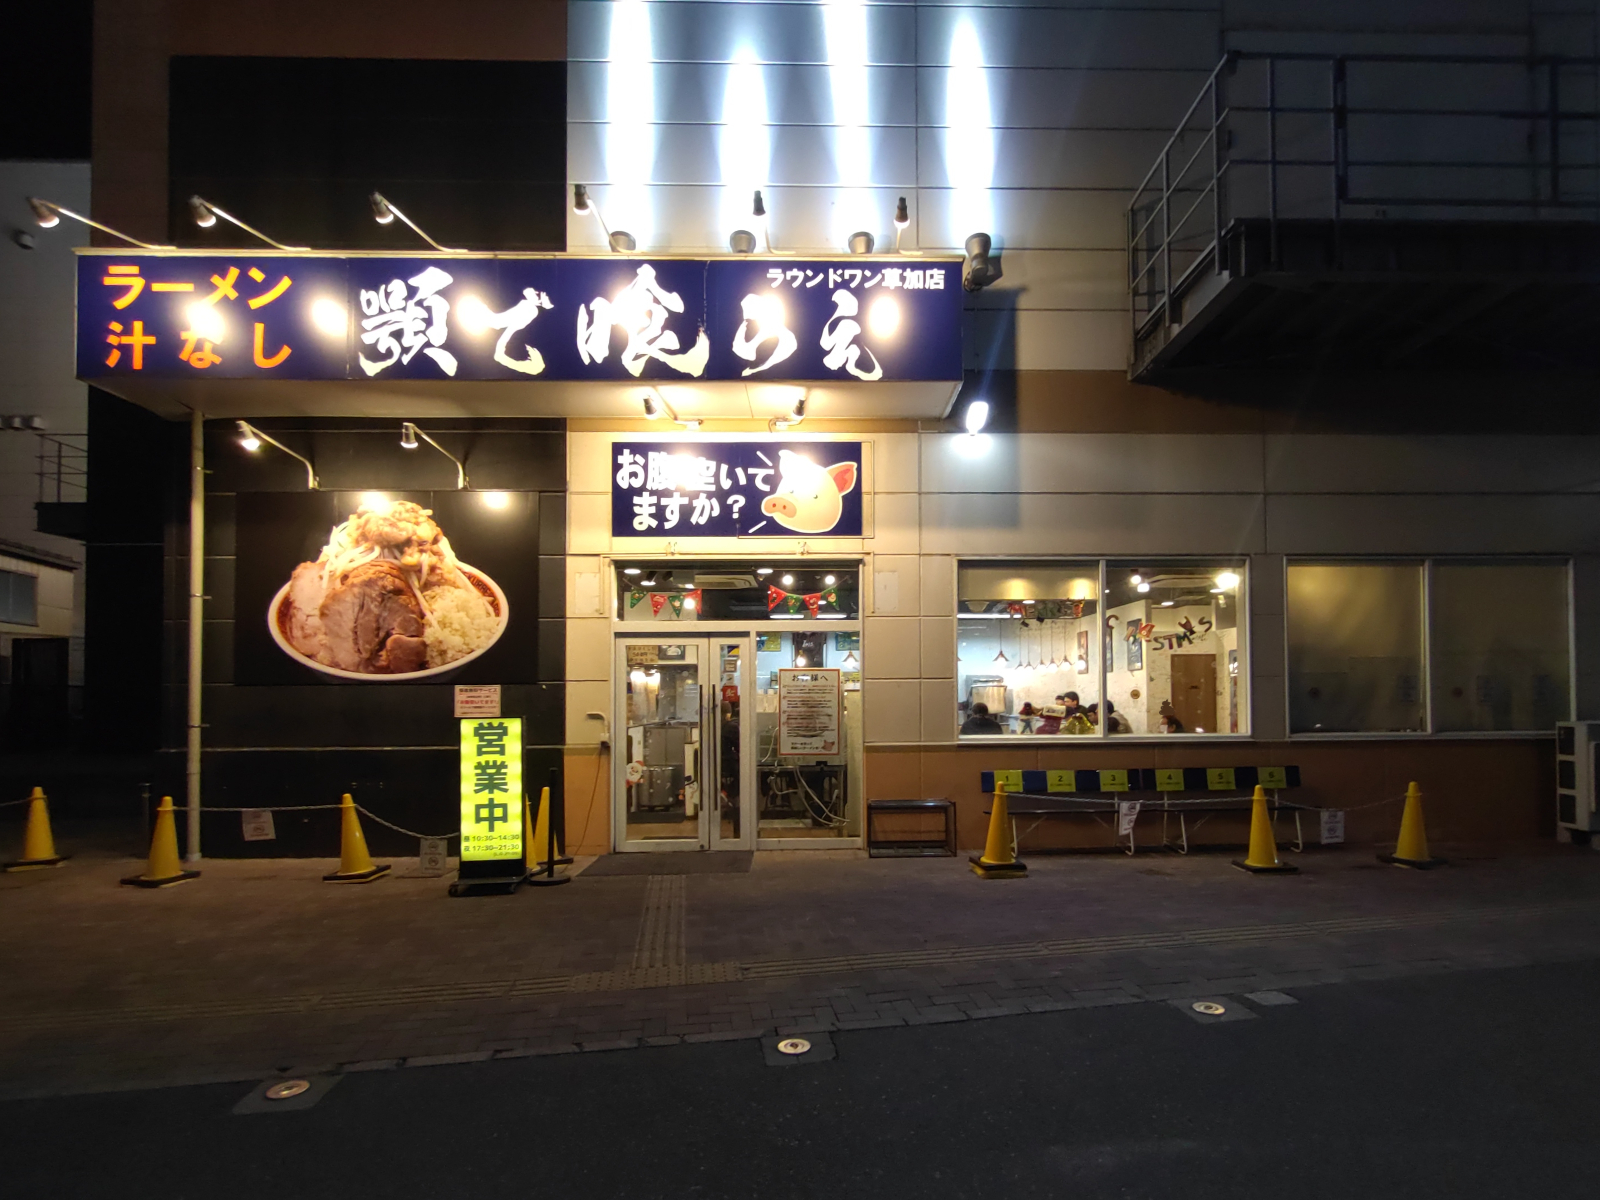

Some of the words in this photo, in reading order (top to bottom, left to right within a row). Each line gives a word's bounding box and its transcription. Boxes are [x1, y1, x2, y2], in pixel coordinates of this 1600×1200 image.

[103, 265, 292, 310] ラーメン
[766, 268, 946, 290] ラウンドワン草加店
[105, 320, 292, 370] 汁なし
[473, 721, 509, 832] 営業中
